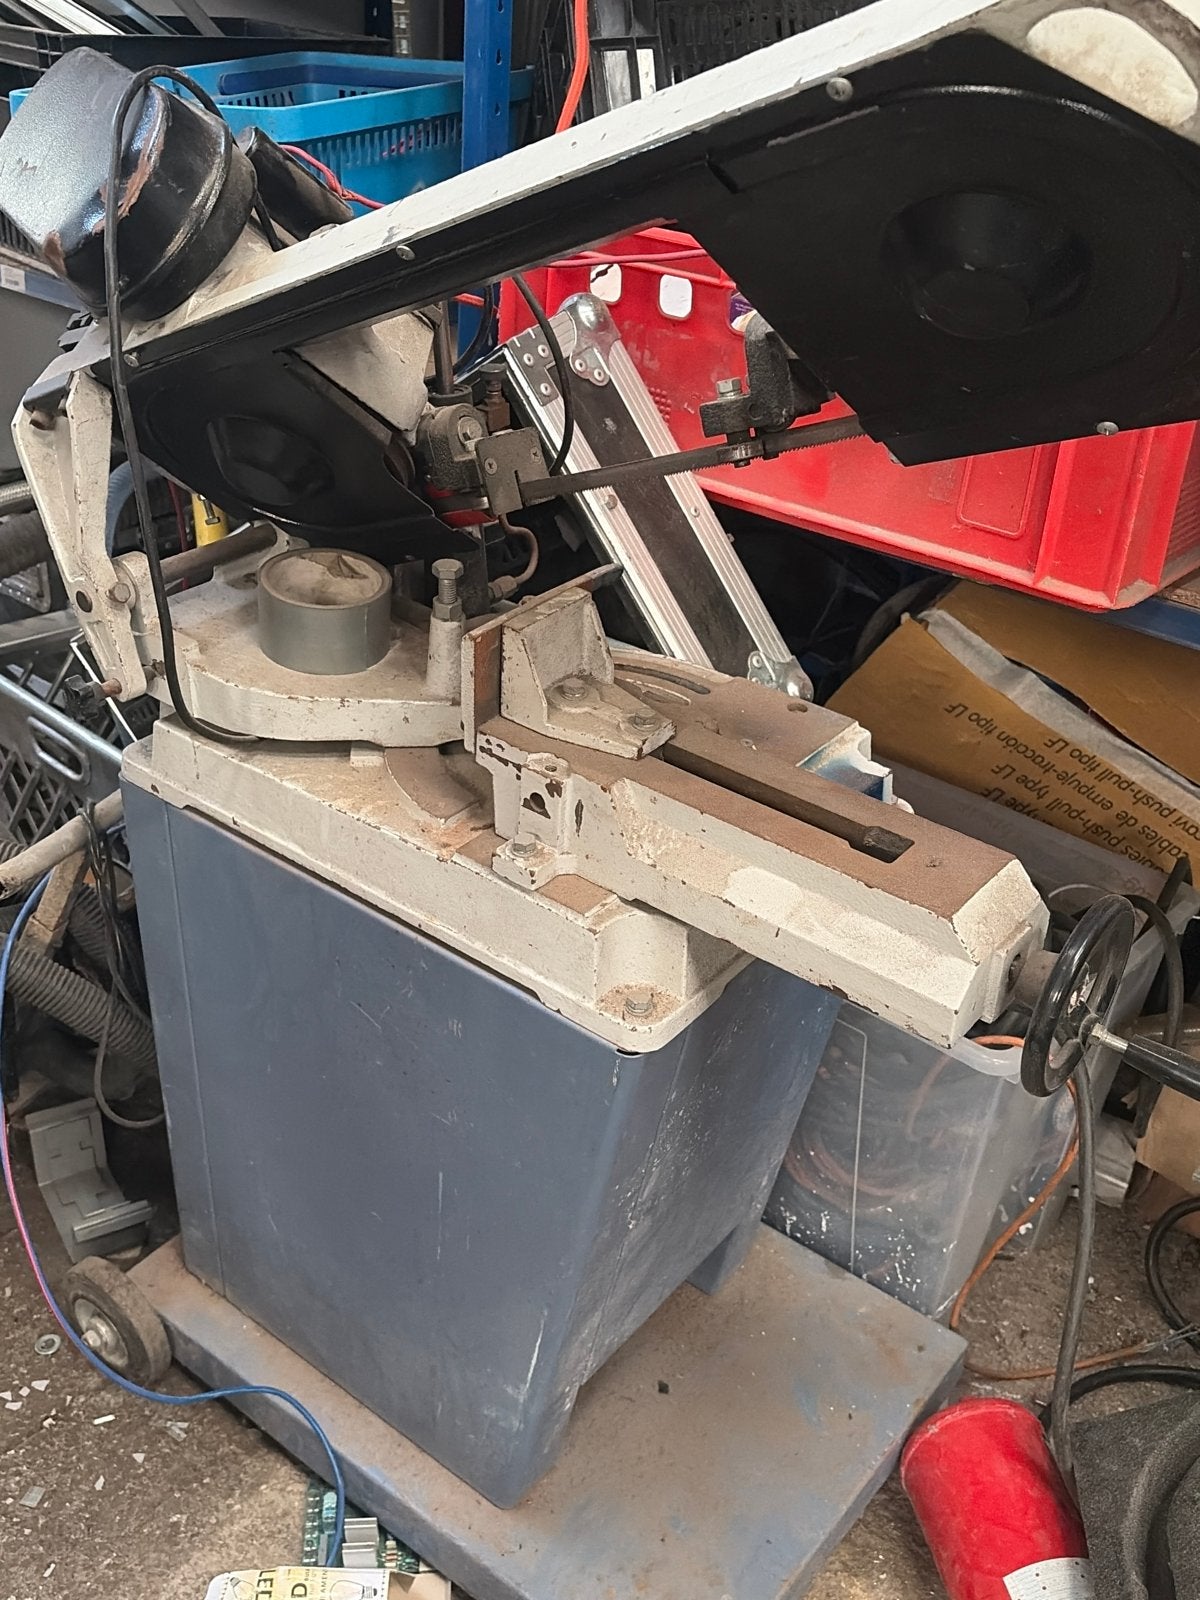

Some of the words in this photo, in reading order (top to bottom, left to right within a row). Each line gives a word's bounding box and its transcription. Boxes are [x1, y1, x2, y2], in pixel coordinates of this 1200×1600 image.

[943, 703, 969, 718] LF
[968, 712, 998, 736] tipo
[1043, 738, 1069, 754] LF
[990, 764, 1016, 780] LF
[996, 731, 1114, 811] empuje-tracción
[1069, 748, 1101, 773] tipo
[1016, 774, 1050, 800] type
[1094, 768, 1177, 819] push-pull
[1045, 798, 1126, 847] push-pull
[1115, 810, 1138, 827] de
[1120, 845, 1169, 875] les
